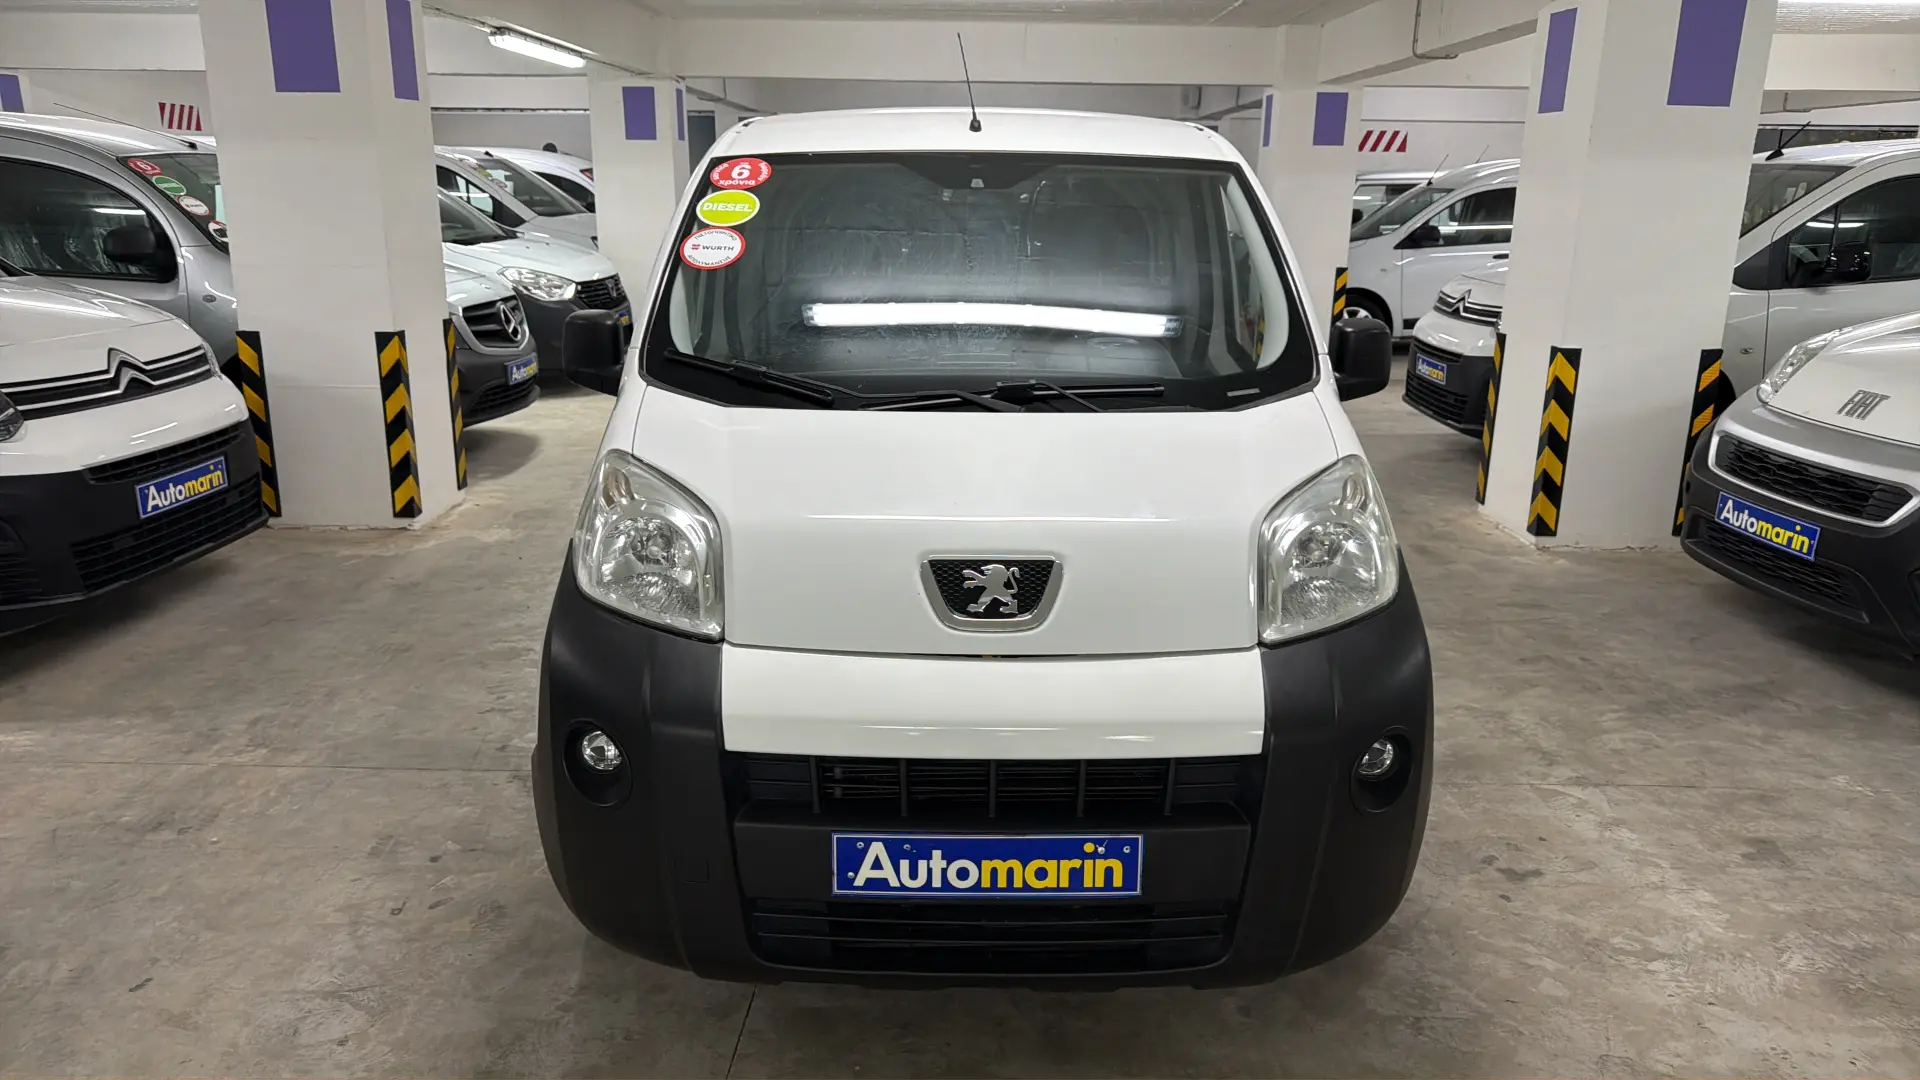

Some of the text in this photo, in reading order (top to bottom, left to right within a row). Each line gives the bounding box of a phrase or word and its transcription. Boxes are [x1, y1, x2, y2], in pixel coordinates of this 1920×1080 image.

[731, 164, 751, 180] 6
[703, 202, 752, 212] DIESEL
[1836, 389, 1892, 421] FIAT
[146, 465, 224, 512] Automarin
[1720, 499, 1810, 554] Automarin
[852, 841, 1123, 889] Automarin
